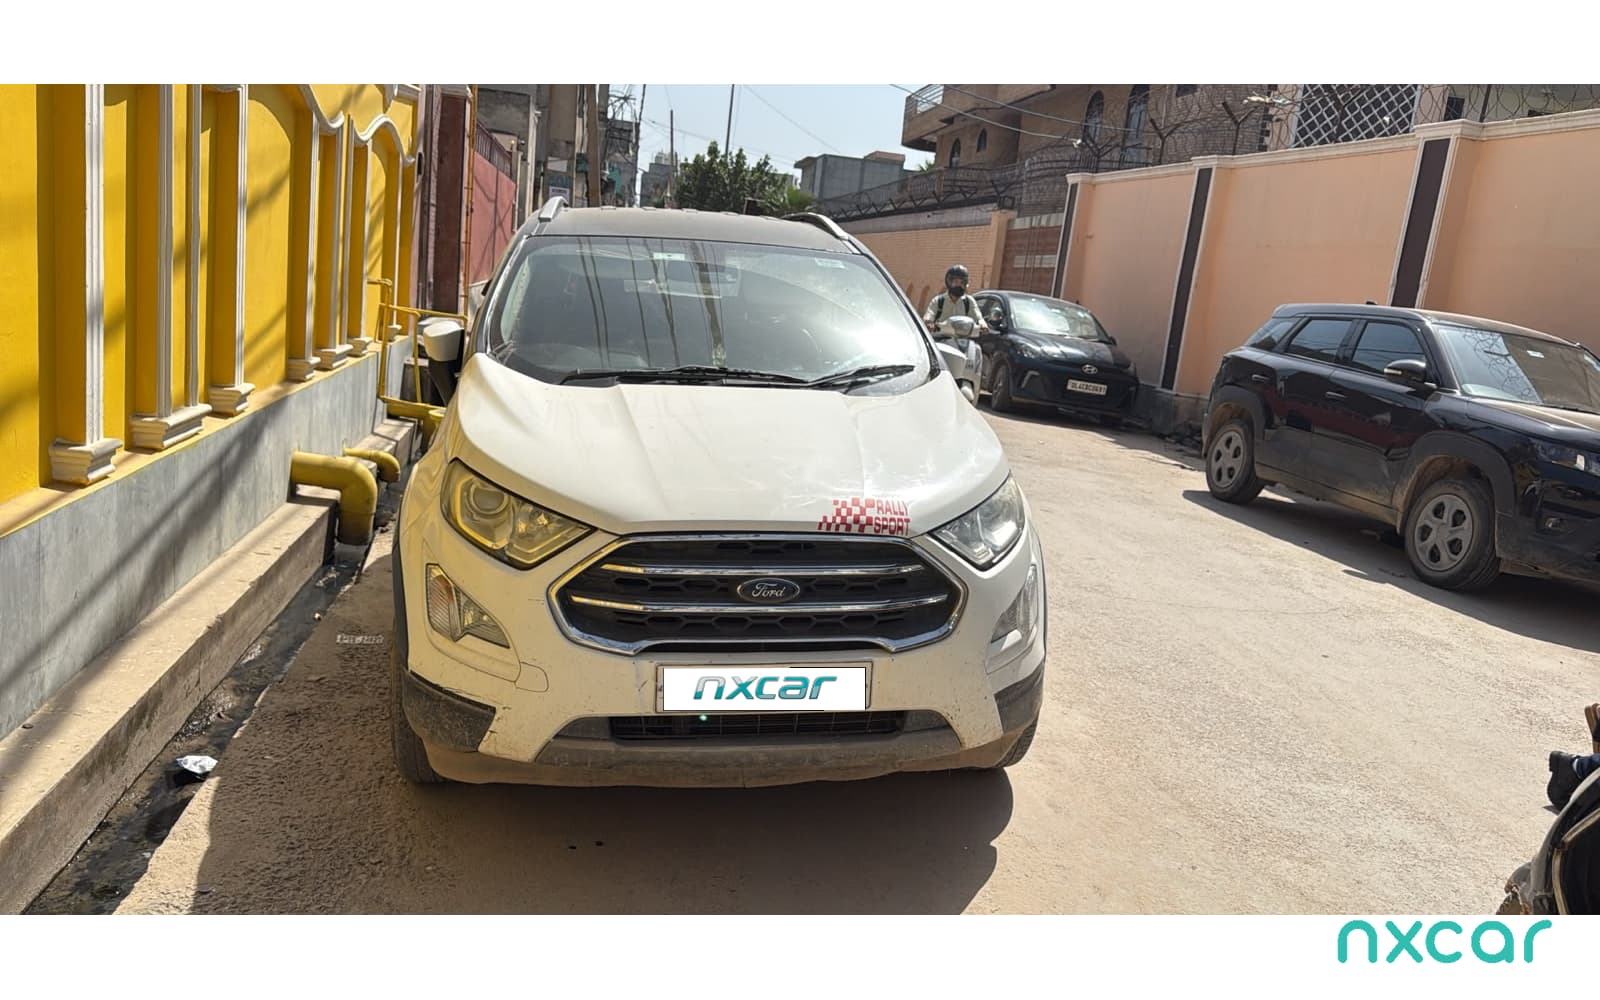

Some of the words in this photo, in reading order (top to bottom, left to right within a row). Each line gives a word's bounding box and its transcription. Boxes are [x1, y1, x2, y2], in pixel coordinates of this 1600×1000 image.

[876, 499, 909, 516] RALLY
[873, 516, 910, 536] SPORT
[751, 582, 786, 597] Ford
